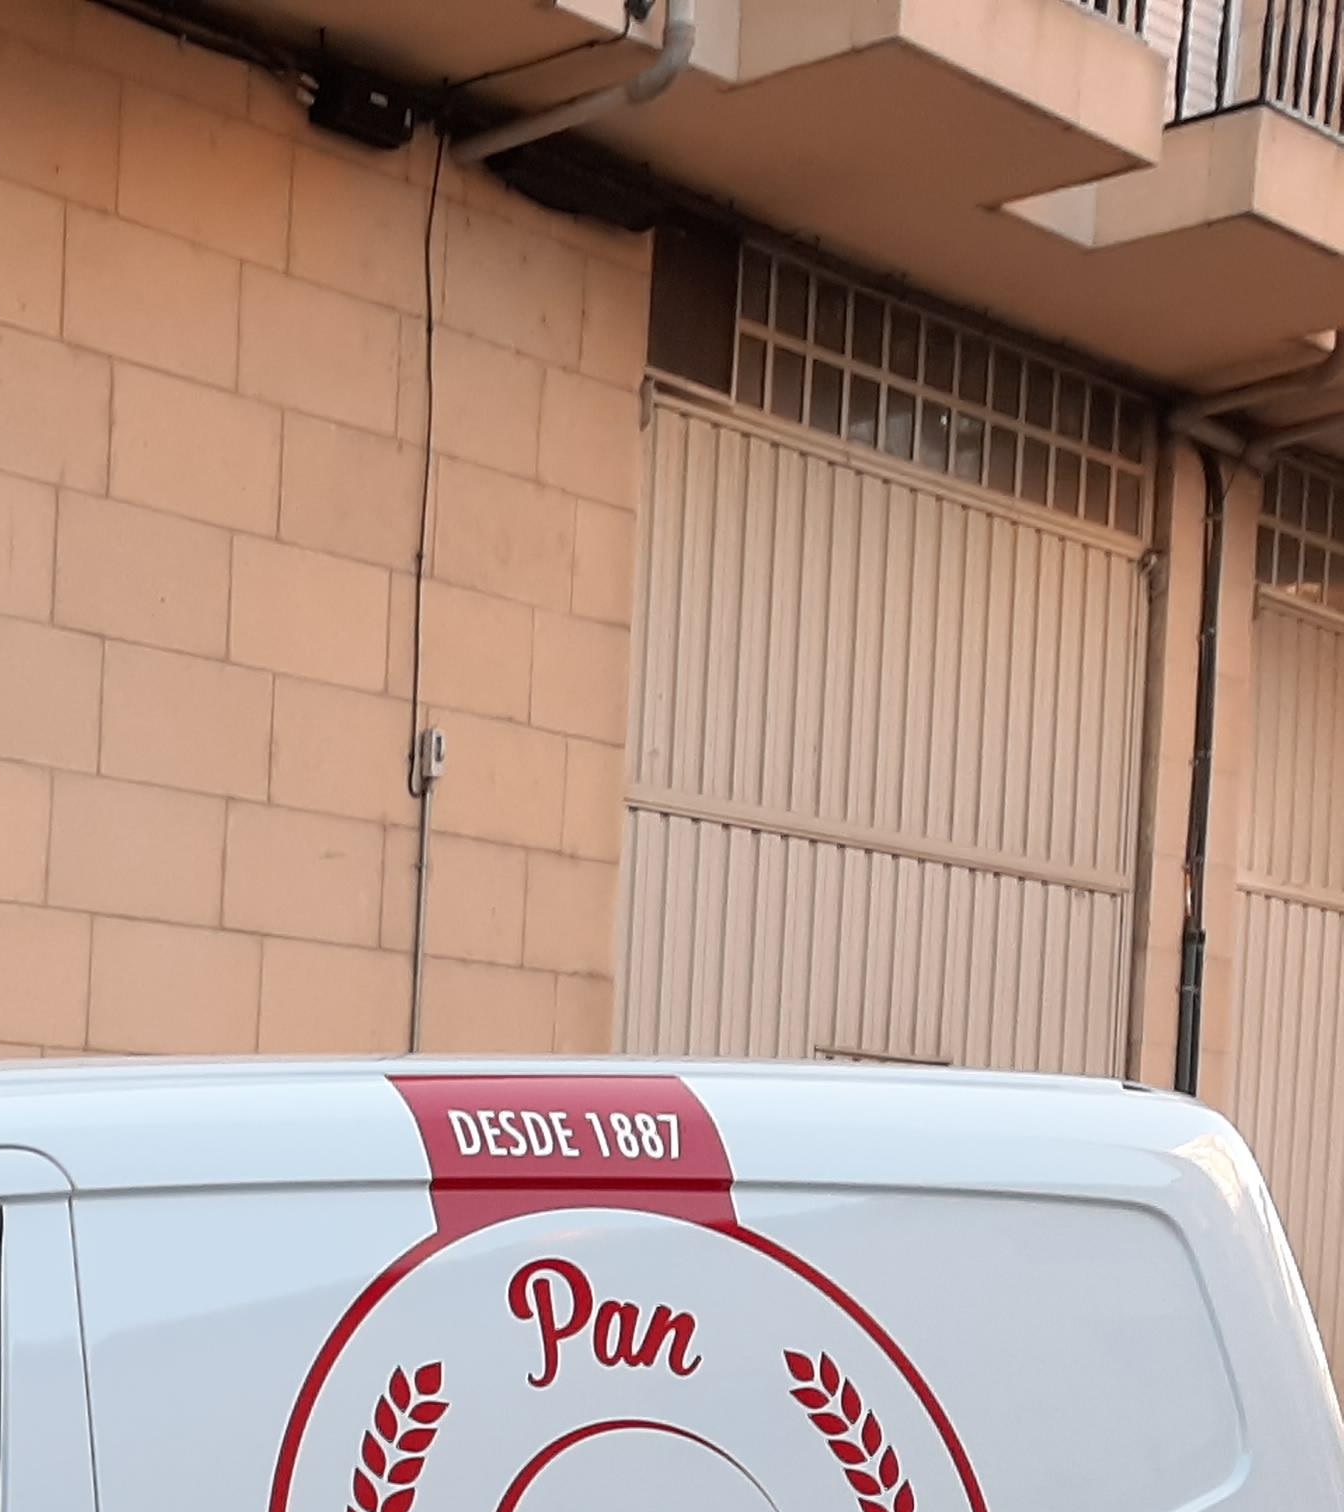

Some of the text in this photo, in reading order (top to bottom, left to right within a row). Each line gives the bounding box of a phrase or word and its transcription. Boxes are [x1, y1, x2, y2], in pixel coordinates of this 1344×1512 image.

[449, 1107, 682, 1160] DESDE 1887
[507, 1257, 701, 1387] Pan
